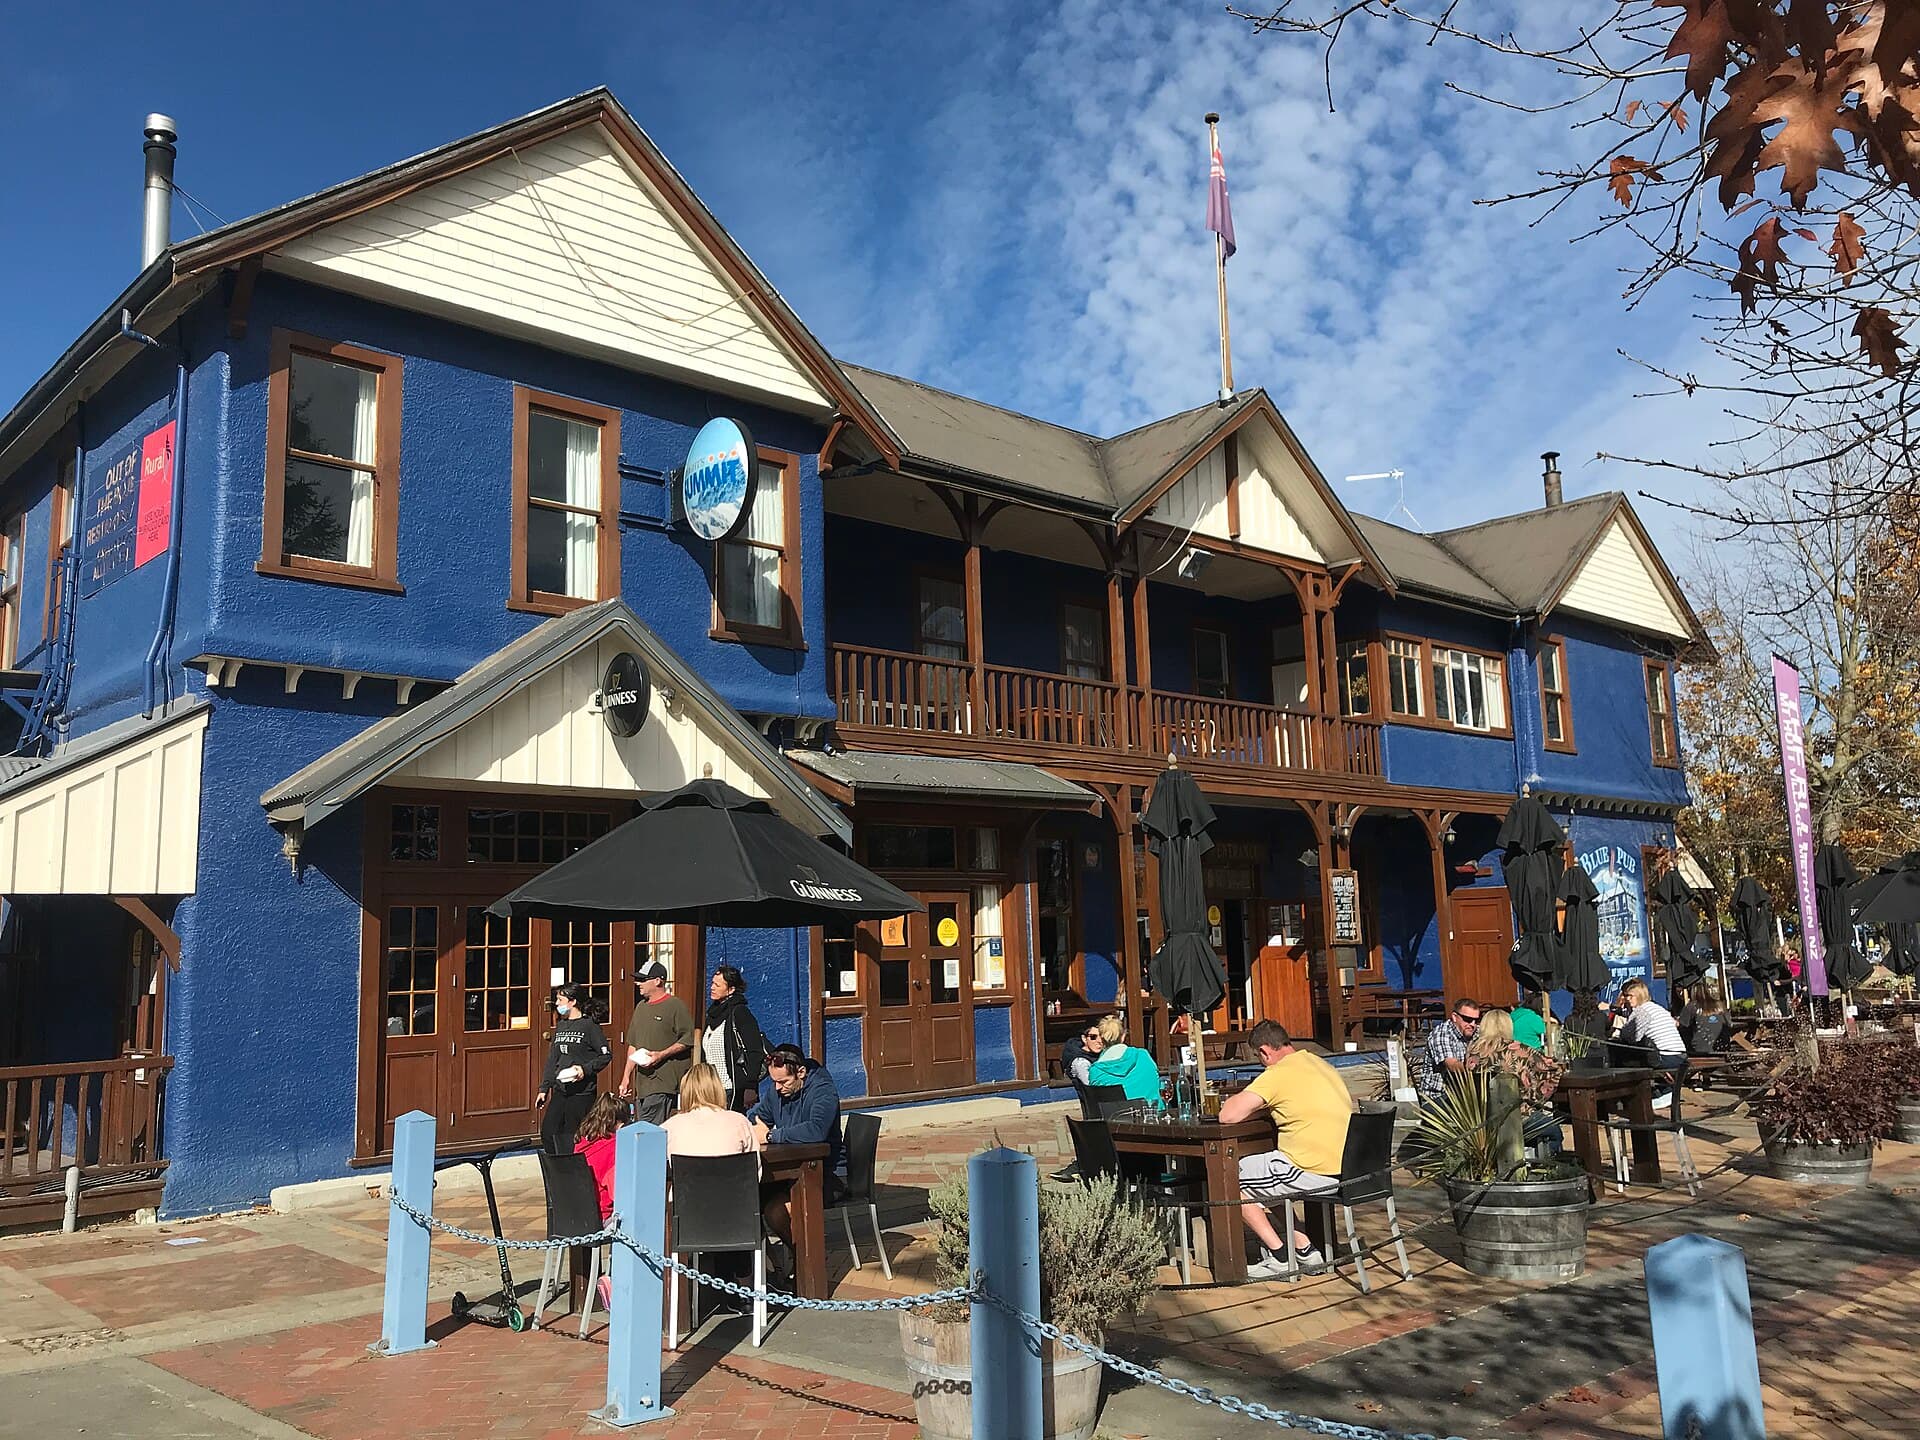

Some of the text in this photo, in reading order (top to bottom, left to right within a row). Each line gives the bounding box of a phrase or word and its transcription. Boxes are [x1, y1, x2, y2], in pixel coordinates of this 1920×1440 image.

[1580, 846, 1636, 876] BLUE PUB
[789, 880, 863, 902] GUINNESS
[1809, 936, 1819, 960] NZ
